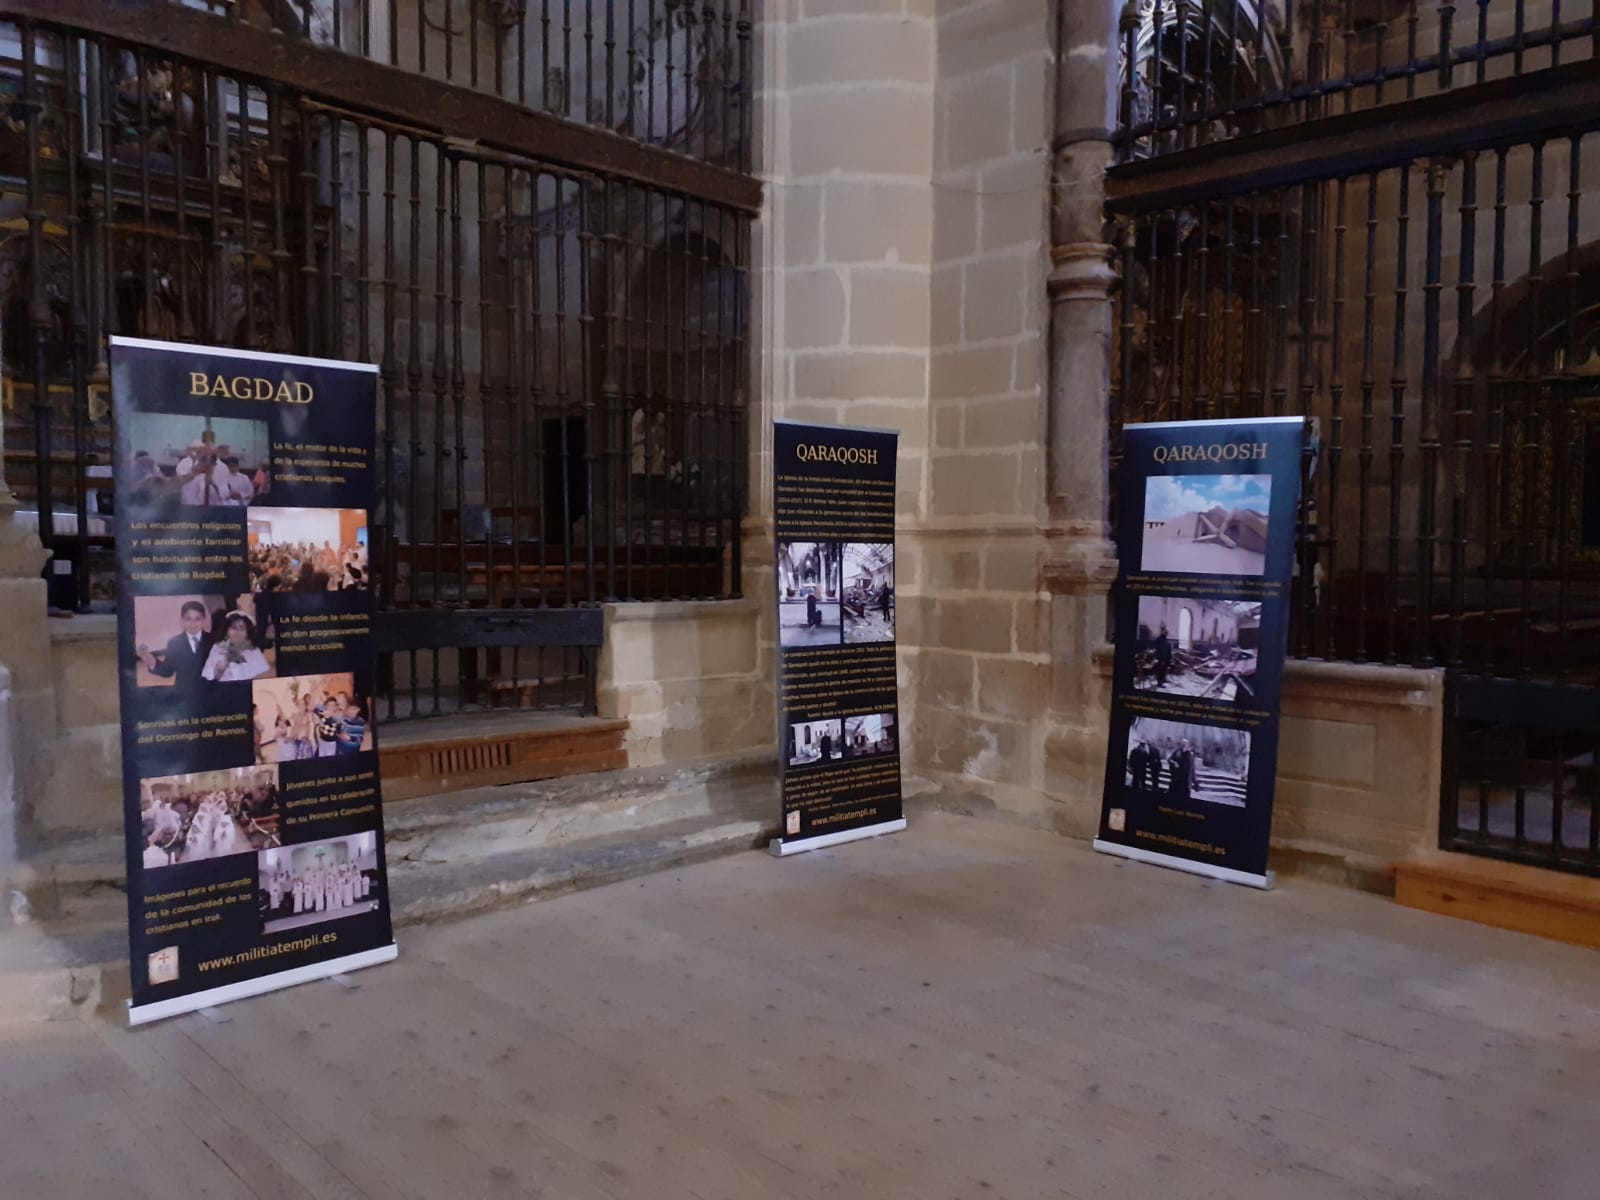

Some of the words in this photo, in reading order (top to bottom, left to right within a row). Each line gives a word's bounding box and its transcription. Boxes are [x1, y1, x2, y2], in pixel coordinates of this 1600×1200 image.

[189, 371, 315, 405] BAGDAD
[796, 443, 878, 465] QARAQOSH
[1152, 442, 1268, 464] QARAQOSH
[205, 538, 242, 546] familiar
[155, 732, 200, 742] Domingo
[201, 730, 214, 738] de
[197, 931, 338, 972] www.militiatempli.es
